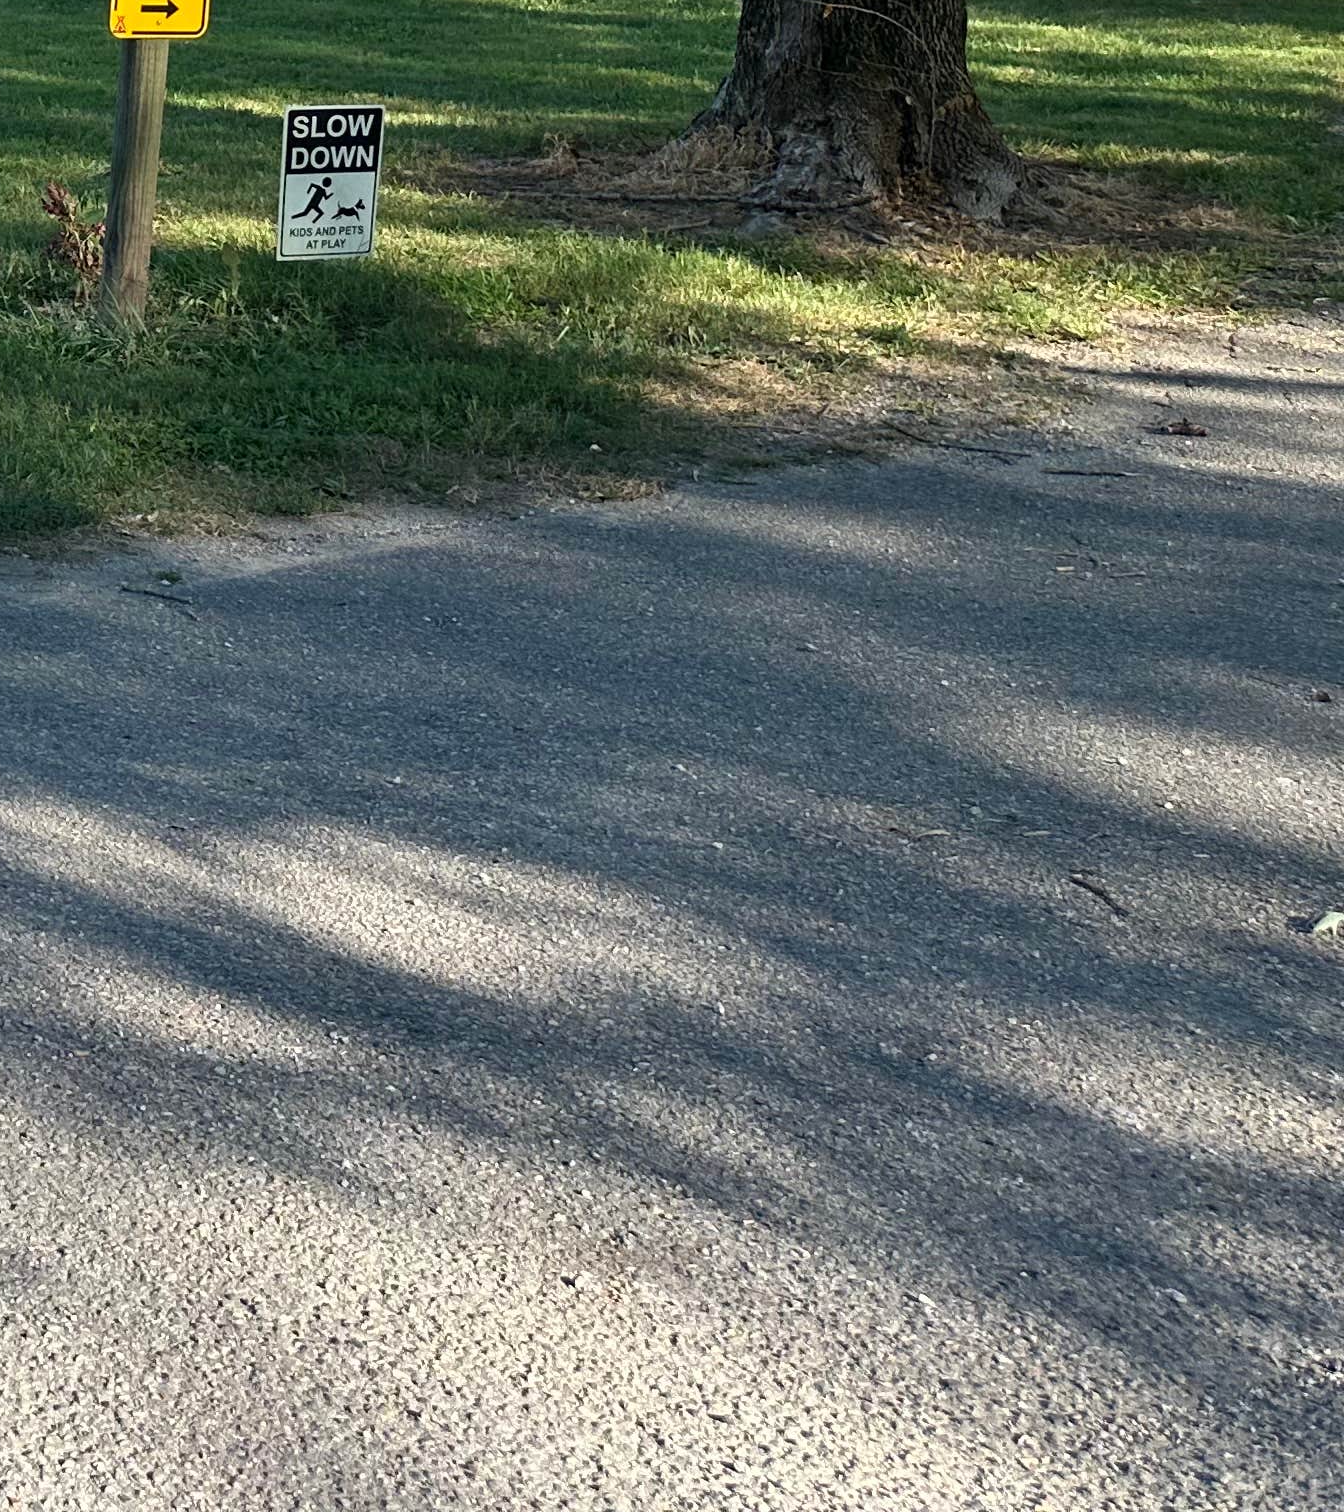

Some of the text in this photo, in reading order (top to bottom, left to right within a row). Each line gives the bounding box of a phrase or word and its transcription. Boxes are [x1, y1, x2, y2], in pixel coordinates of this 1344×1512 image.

[292, 114, 374, 138] SLOW
[290, 145, 374, 170] DOWN
[289, 225, 364, 237] KIDS AND PETS
[306, 238, 347, 249] AT PLAY
